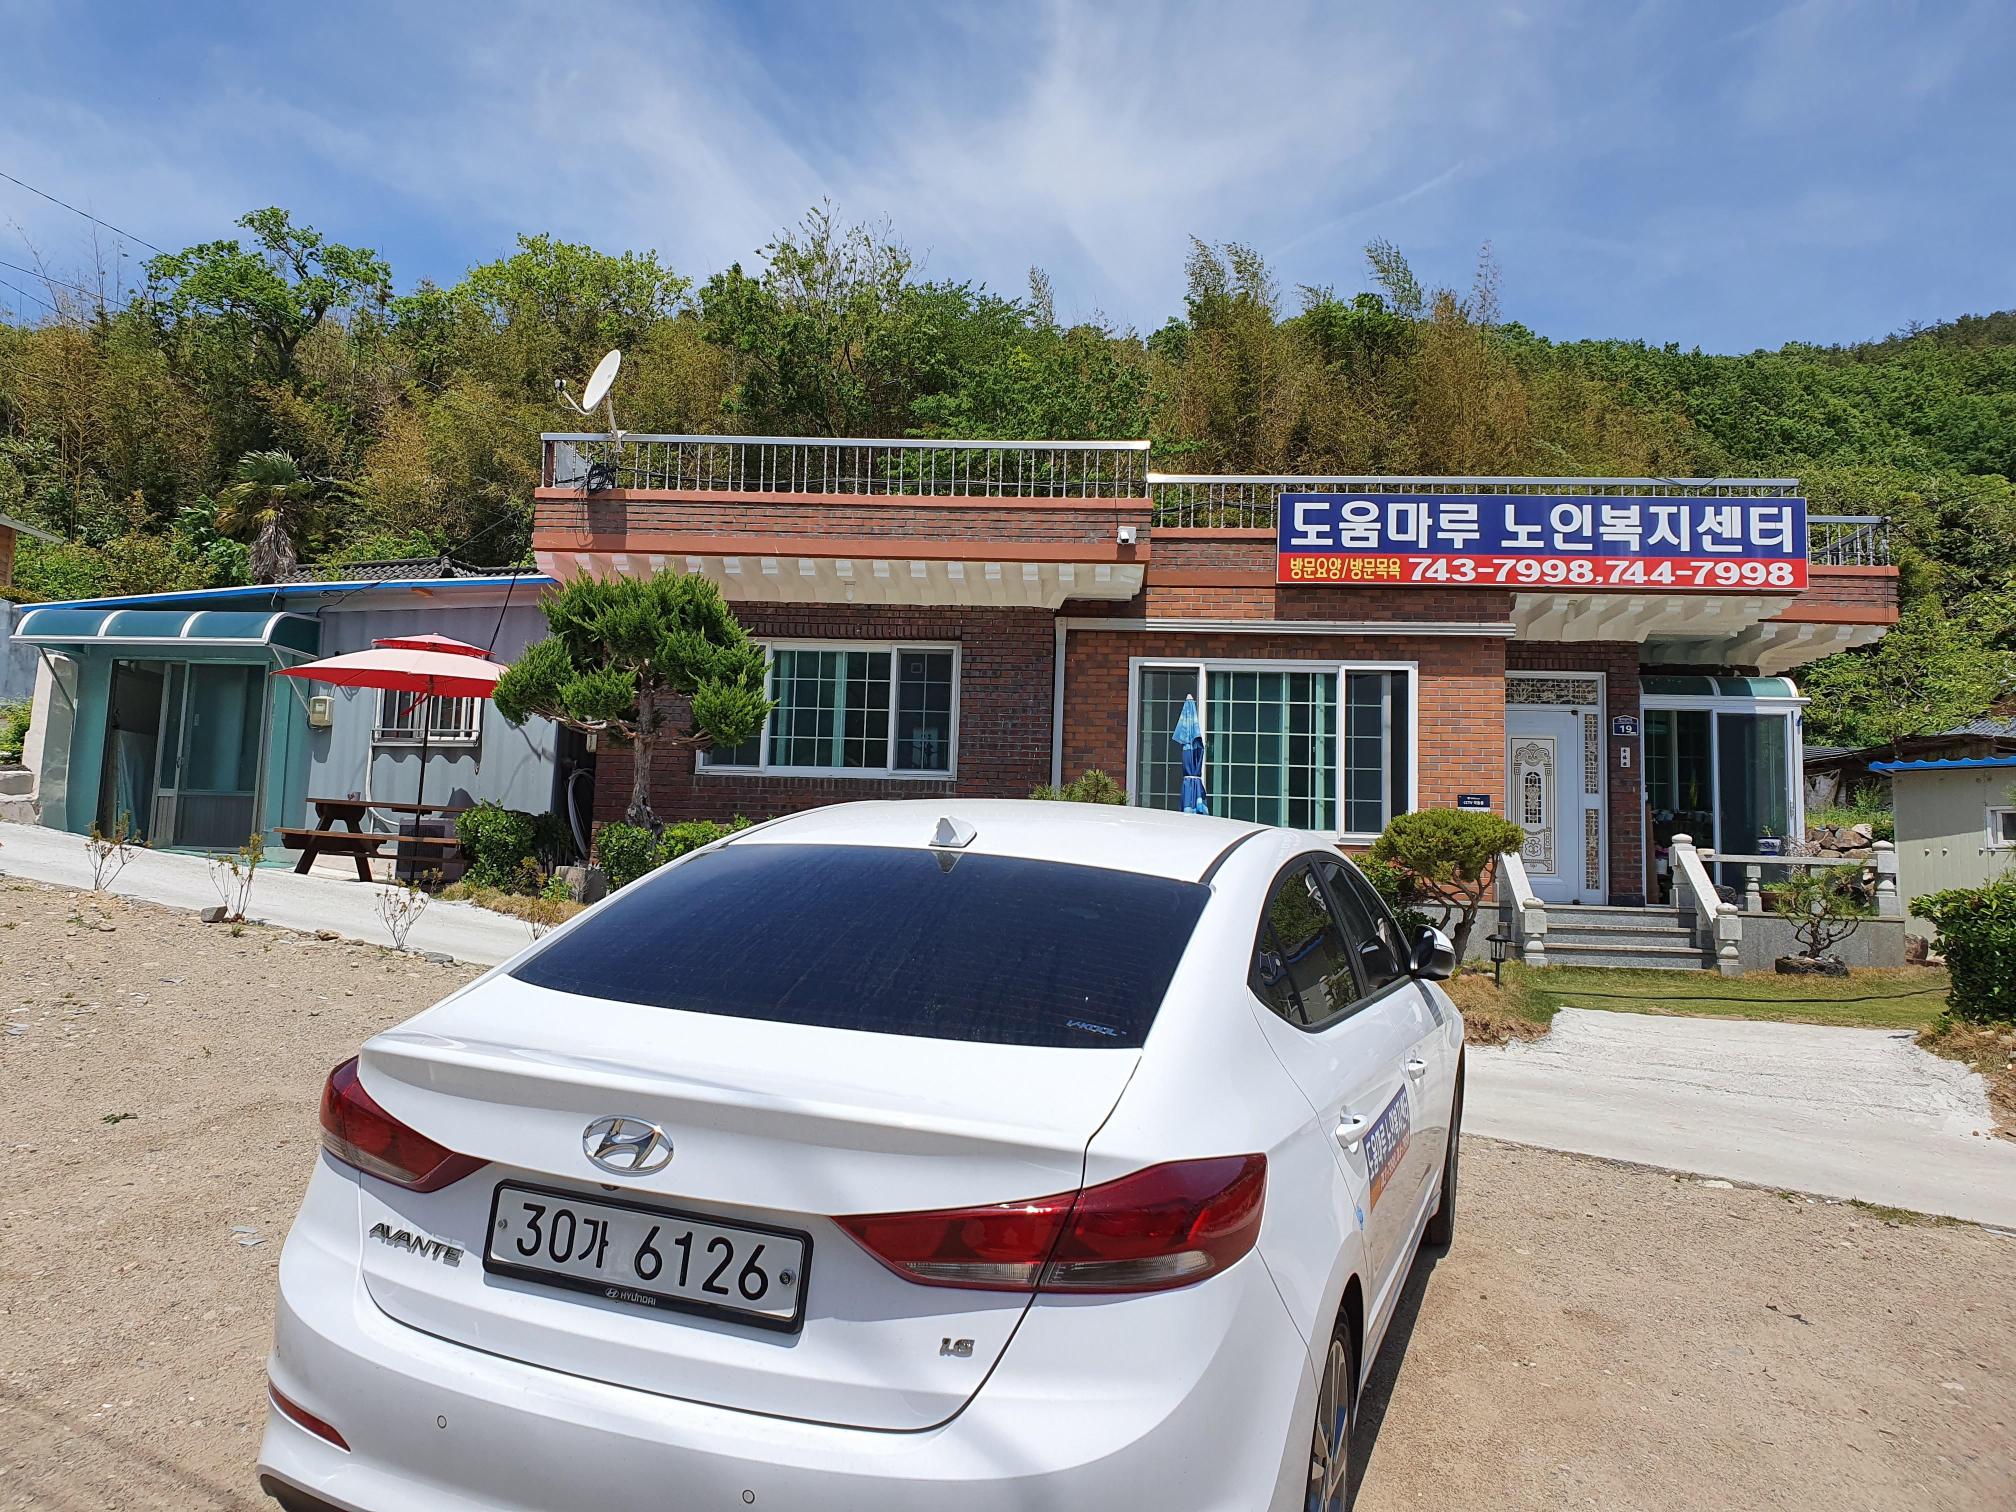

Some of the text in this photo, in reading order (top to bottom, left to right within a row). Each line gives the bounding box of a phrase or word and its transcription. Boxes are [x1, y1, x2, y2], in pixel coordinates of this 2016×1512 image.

[1290, 501, 1793, 553] 도움마루 노인복지센터
[1290, 557, 1794, 585] 방문요양/방문목욕 743-7998,744-7998
[1619, 725, 1633, 733] 19
[369, 1222, 465, 1267] AVANTE
[516, 1202, 769, 1302] 30가 6126
